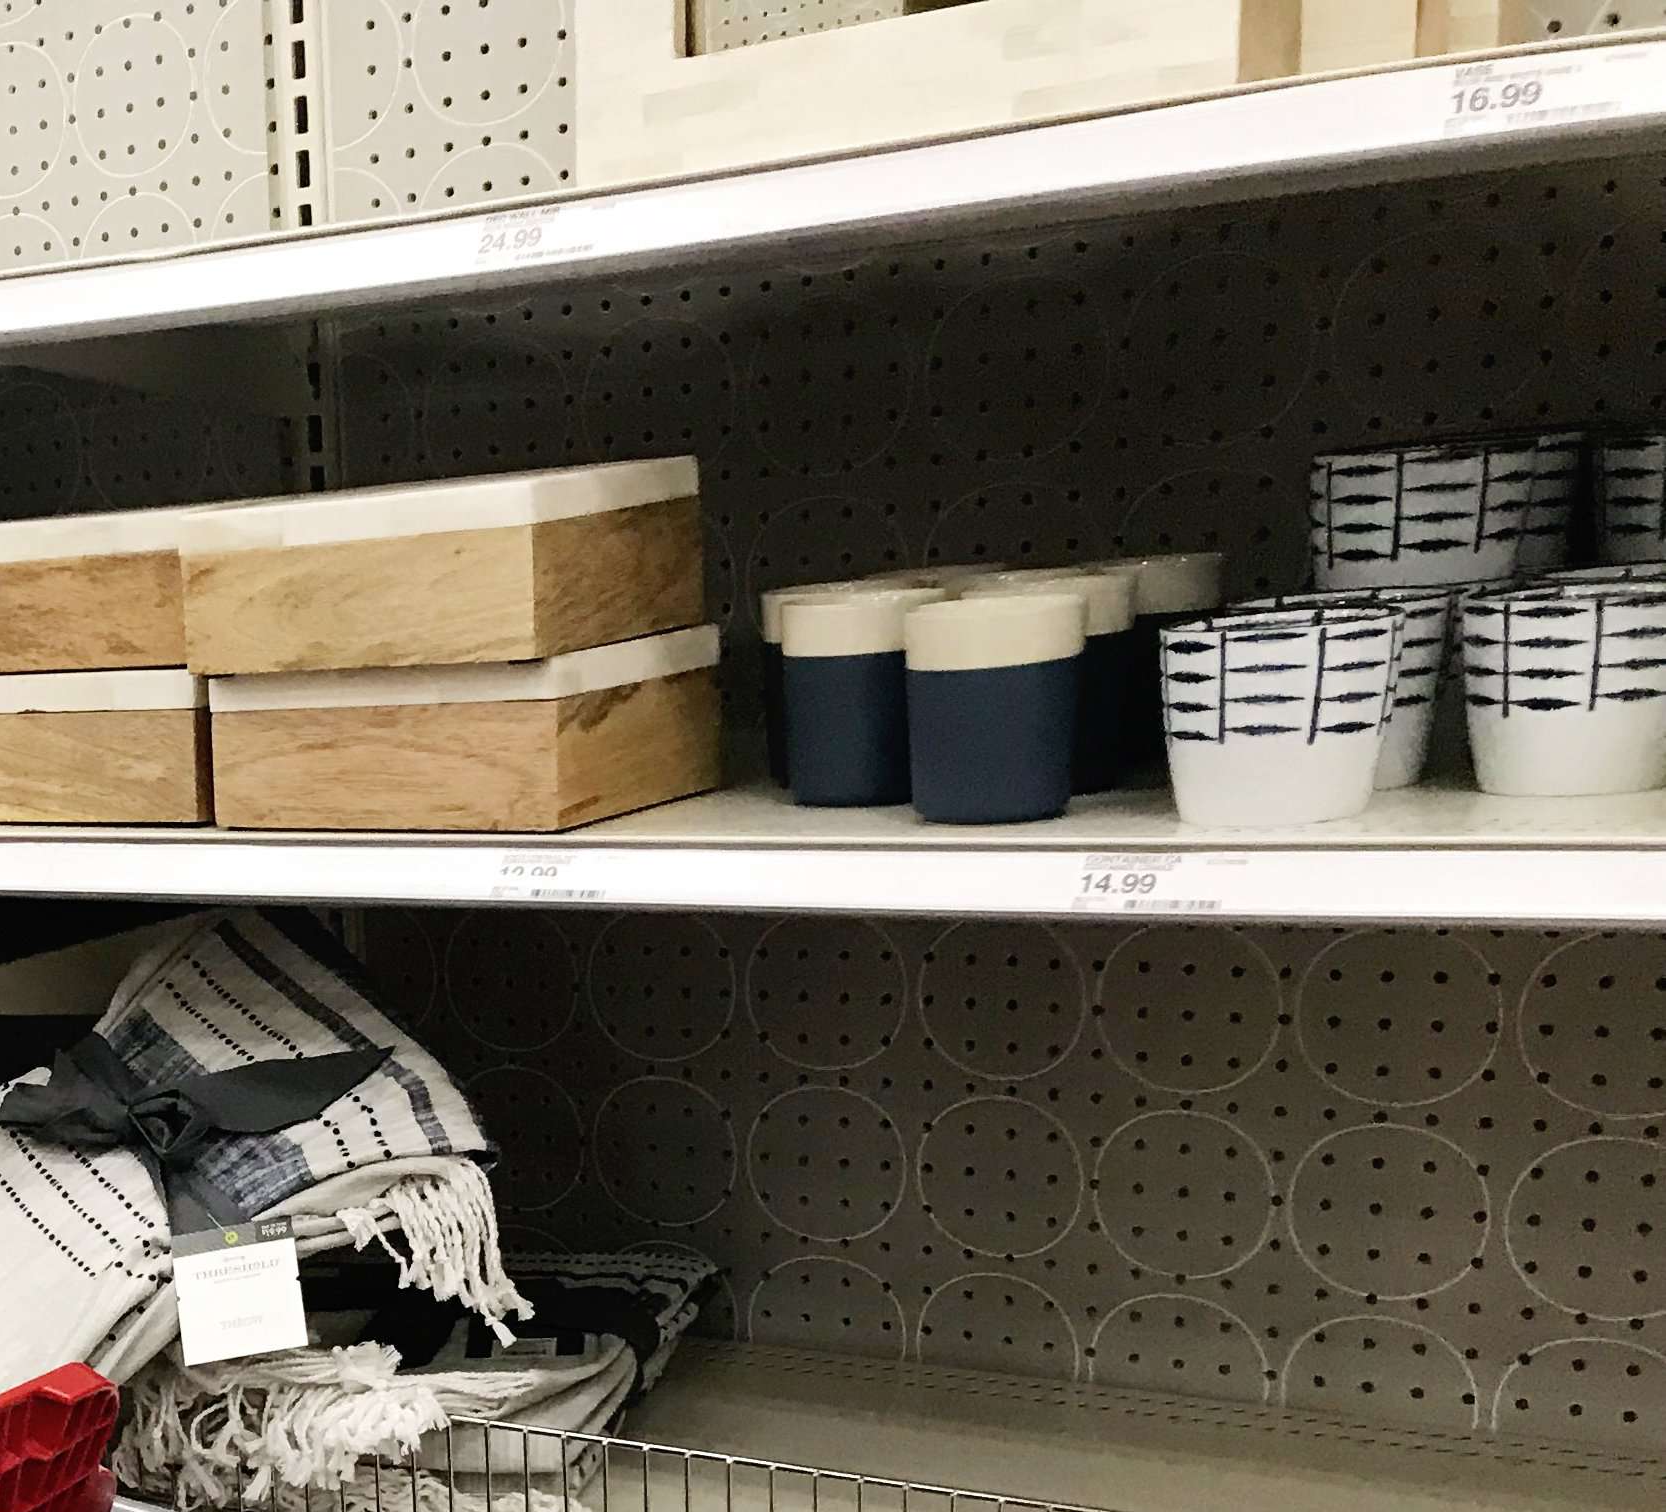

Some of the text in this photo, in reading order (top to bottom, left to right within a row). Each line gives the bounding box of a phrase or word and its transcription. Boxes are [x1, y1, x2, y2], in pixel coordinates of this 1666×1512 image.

[1451, 81, 1544, 114] 16.99
[478, 226, 542, 254] 24.99
[1081, 873, 1157, 894] 14.99
